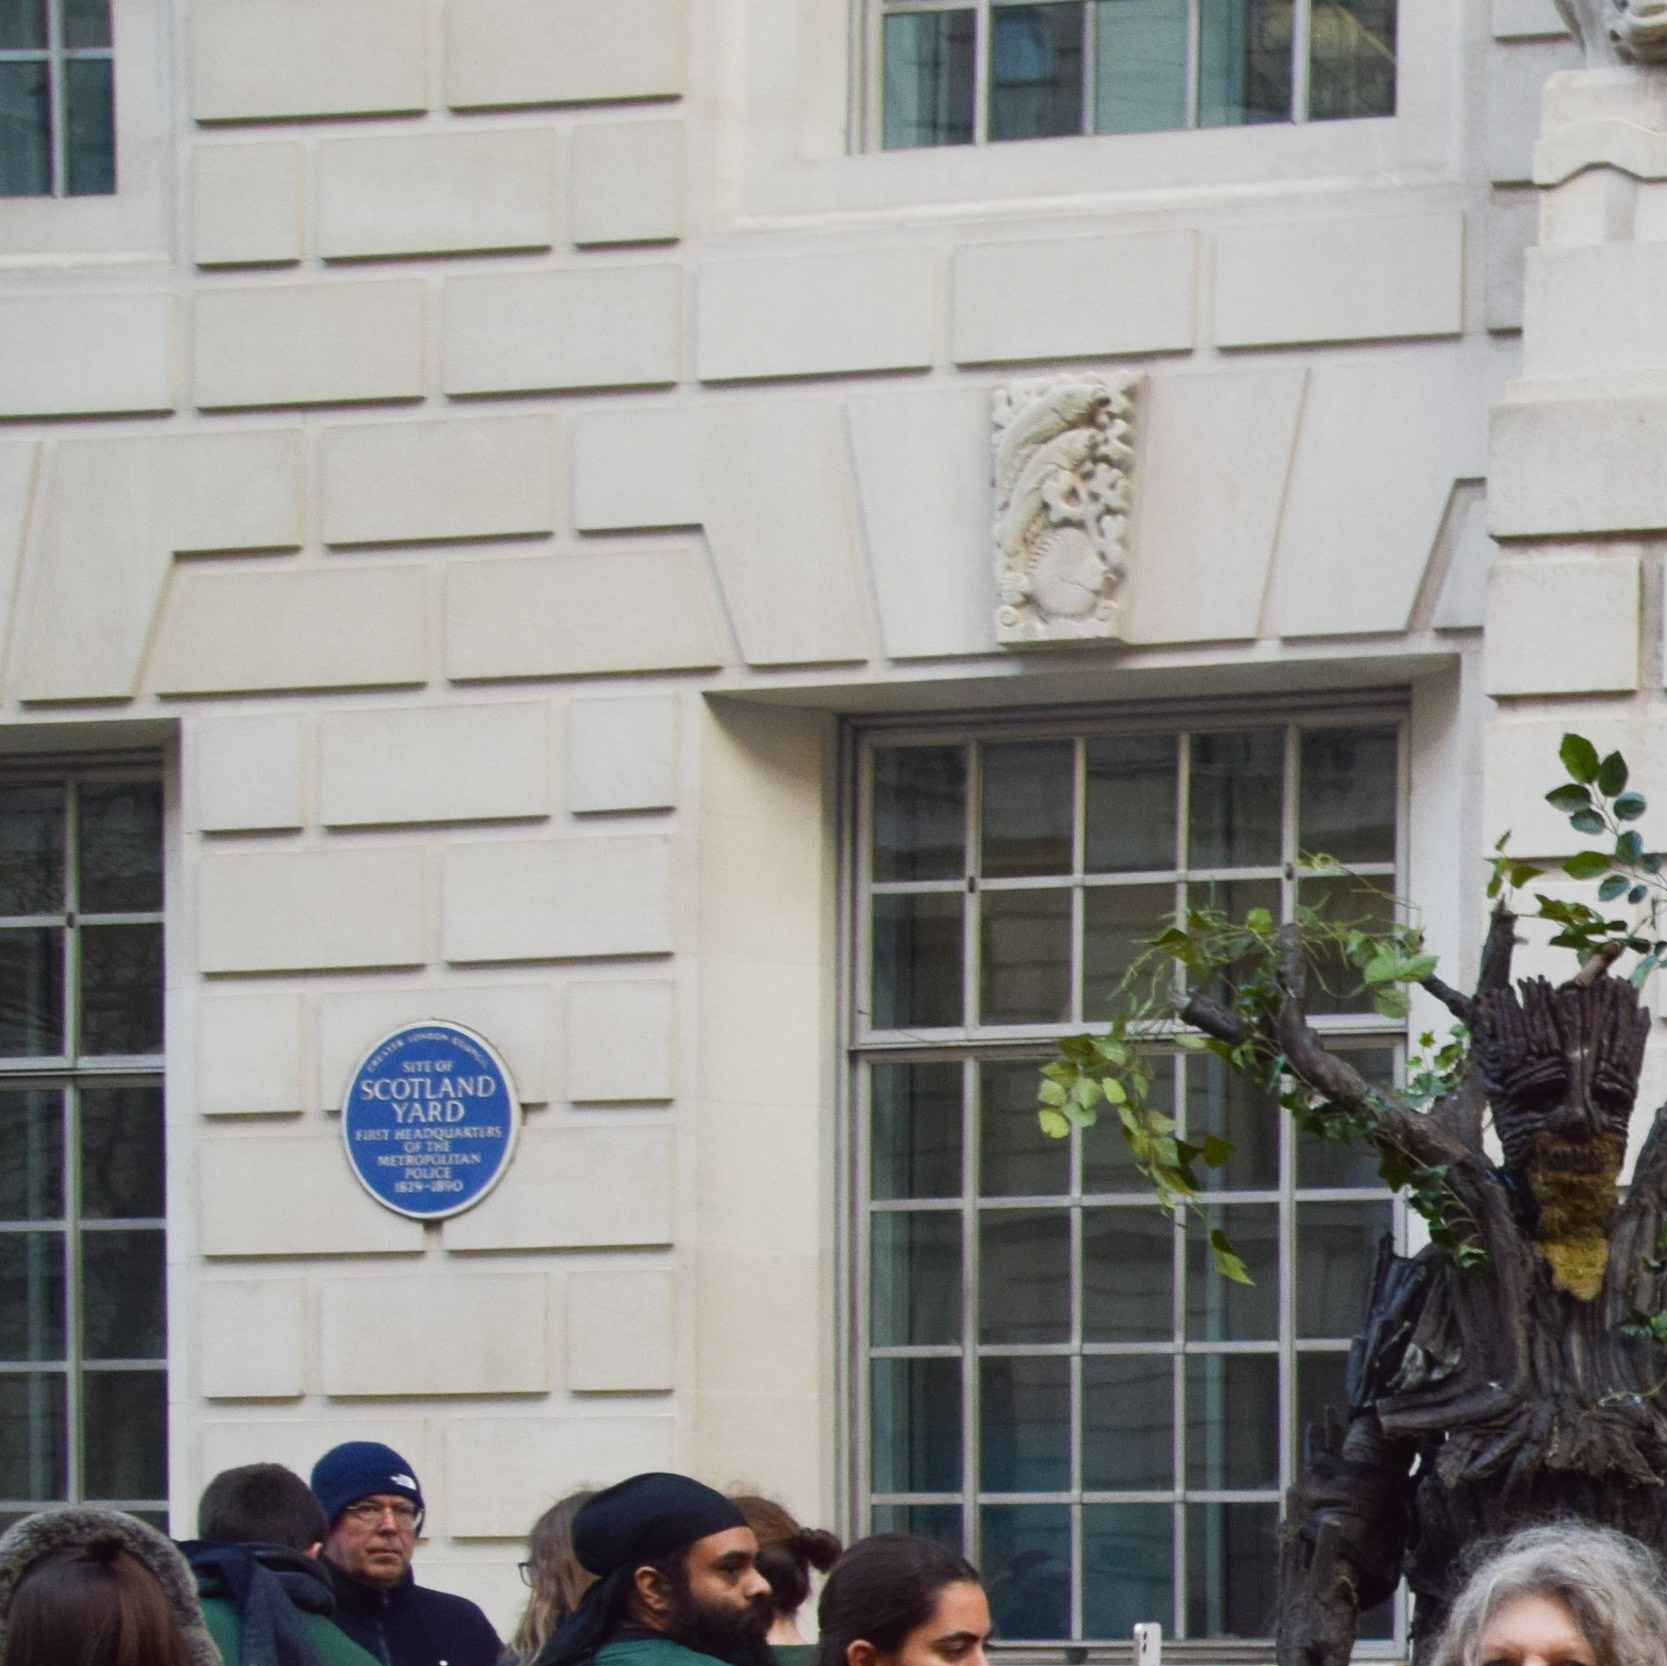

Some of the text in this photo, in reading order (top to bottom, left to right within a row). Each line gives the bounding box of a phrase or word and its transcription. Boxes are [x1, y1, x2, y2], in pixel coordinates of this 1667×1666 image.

[402, 1060, 454, 1073] SITE OF
[360, 1075, 496, 1101] SCOTLAND
[391, 1101, 465, 1124] YARD
[355, 1126, 501, 1141] FIRST HEADQUARTERS
[403, 1141, 450, 1153] OF THE
[377, 1153, 481, 1167] METROPOLITAN
[404, 1167, 452, 1179] POLICE
